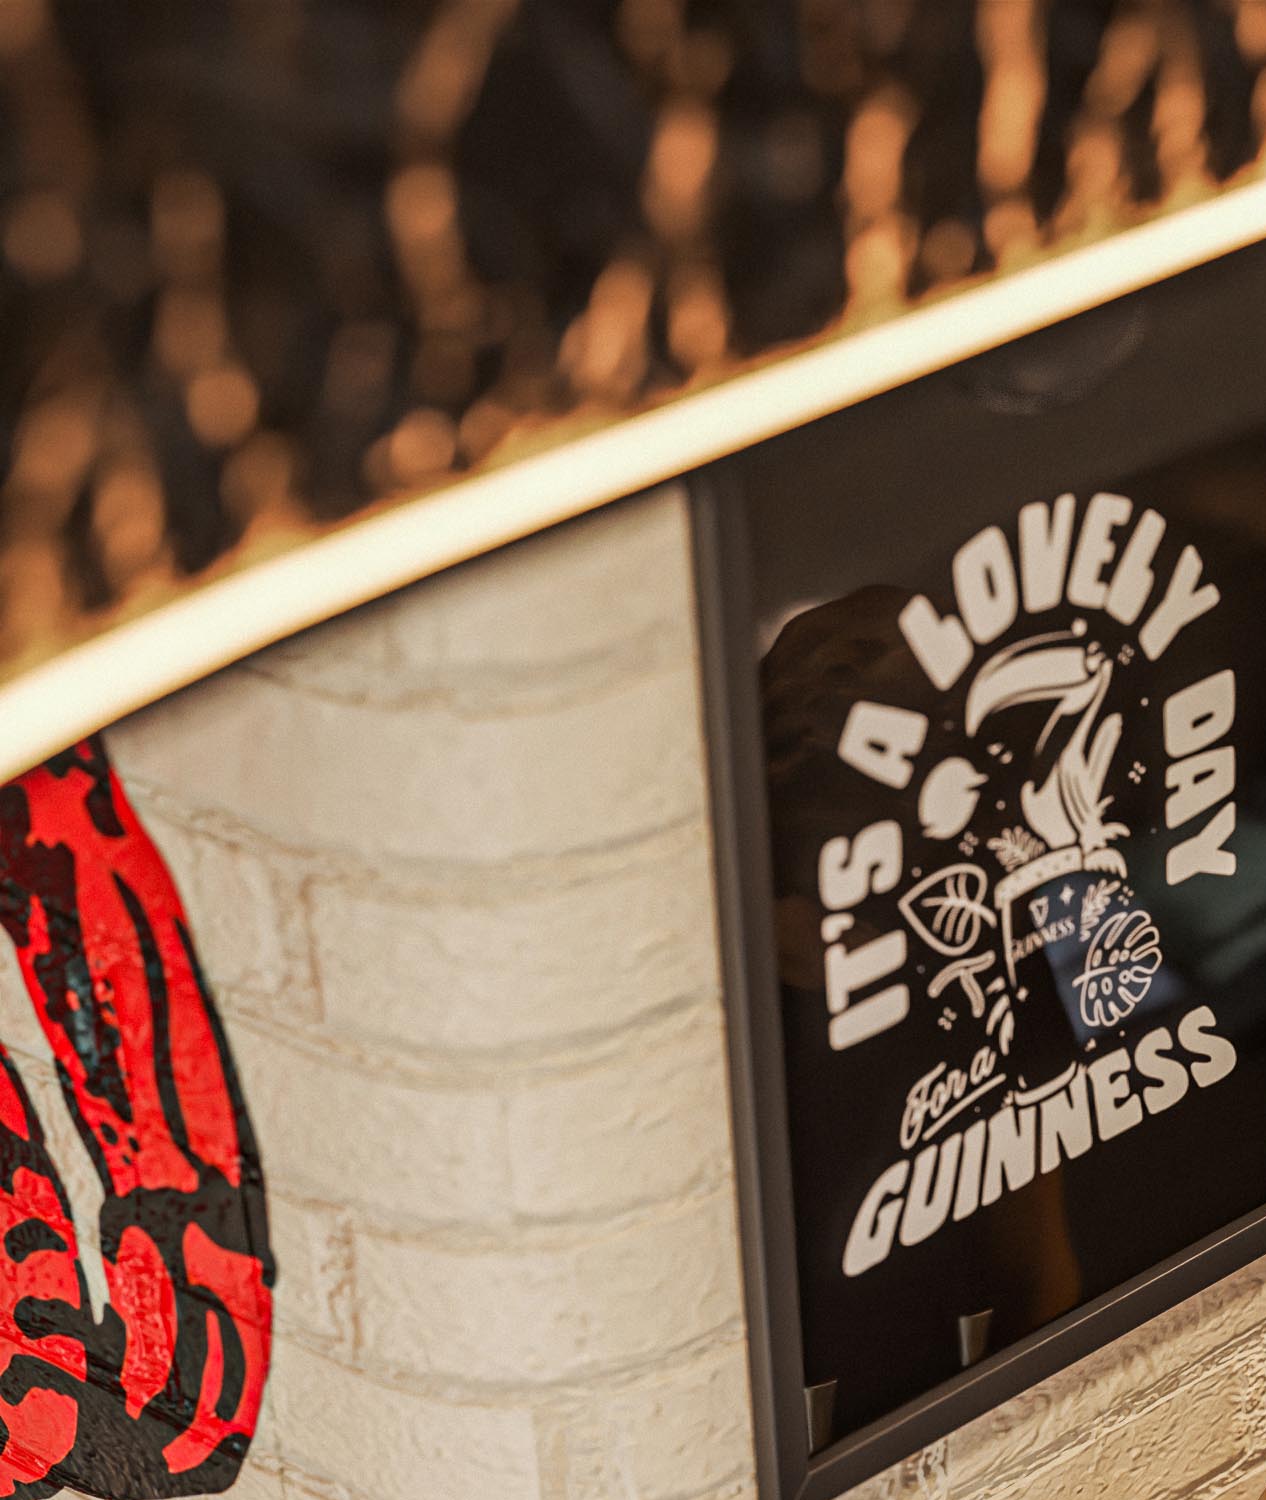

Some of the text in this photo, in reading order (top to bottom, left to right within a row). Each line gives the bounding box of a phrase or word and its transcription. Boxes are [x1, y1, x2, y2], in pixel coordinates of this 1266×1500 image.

[818, 492, 1236, 1051] IT'S A LOVELY DAY
[842, 1005, 1237, 1278] GUINNESS
[901, 1046, 996, 1149] For a
